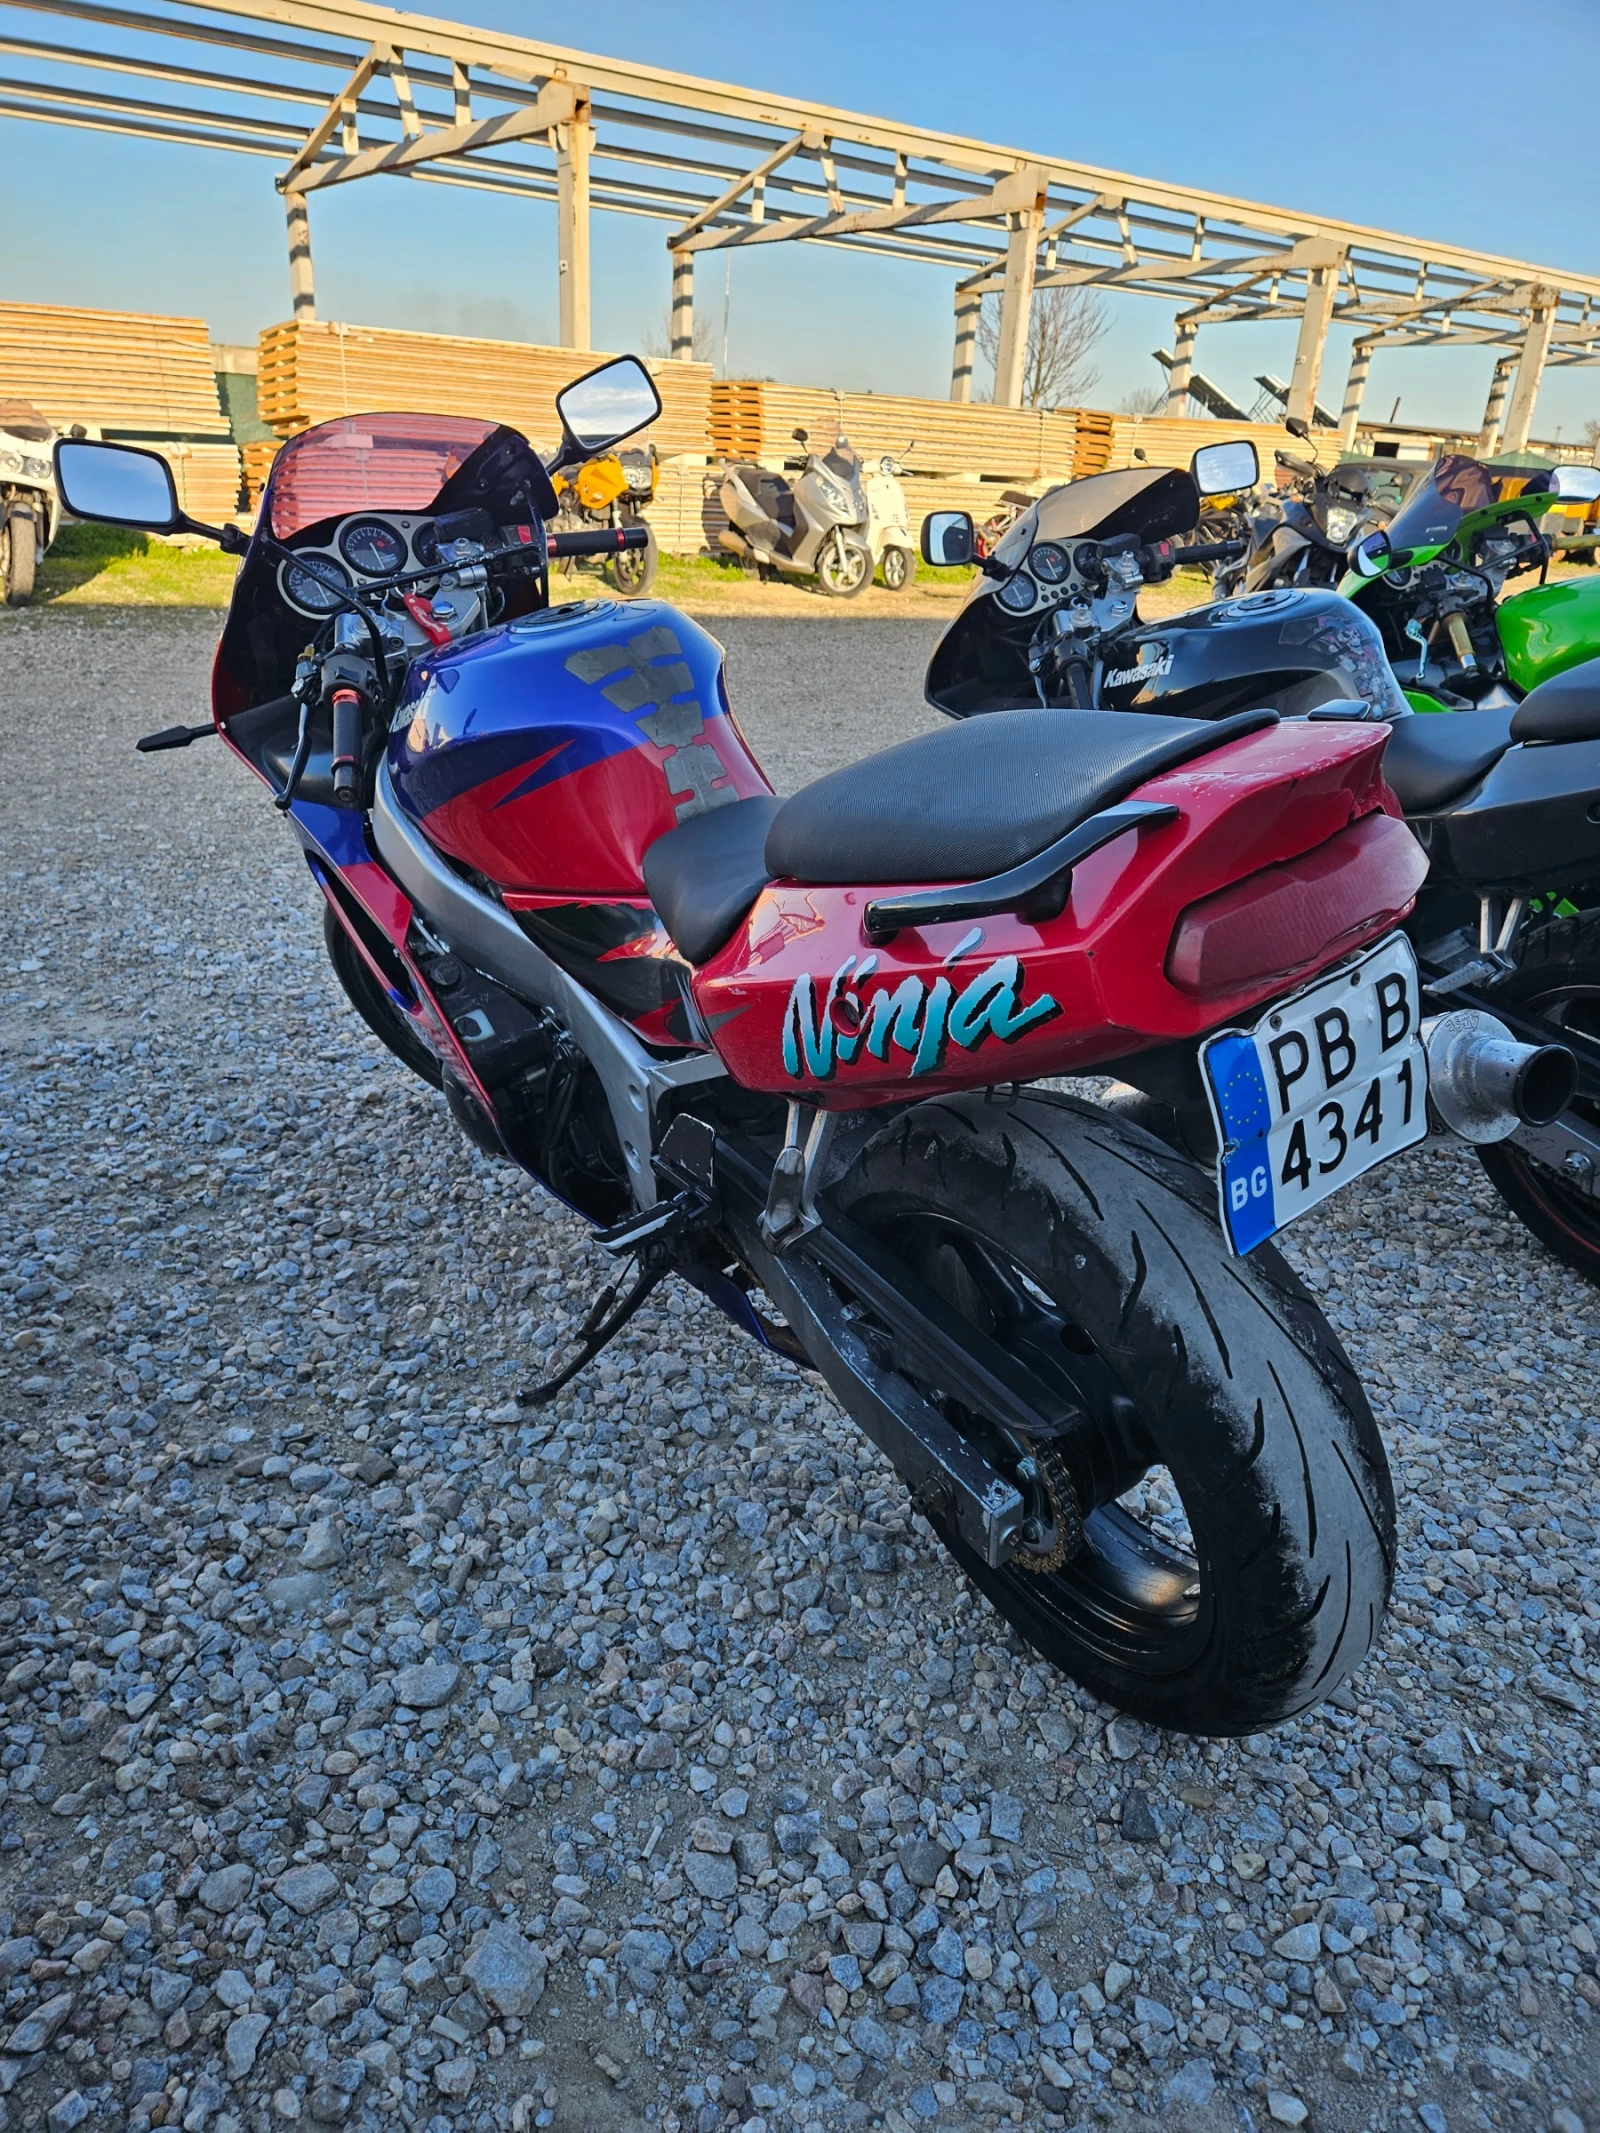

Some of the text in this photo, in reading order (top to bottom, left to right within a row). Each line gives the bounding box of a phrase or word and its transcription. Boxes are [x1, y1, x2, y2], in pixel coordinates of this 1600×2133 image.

[1103, 654, 1175, 688] Kawasaki
[782, 927, 1063, 1080] Ninja
[1268, 972, 1411, 1116] PB B
[1231, 1165, 1267, 1212] BG
[1281, 1058, 1413, 1191] 4341
